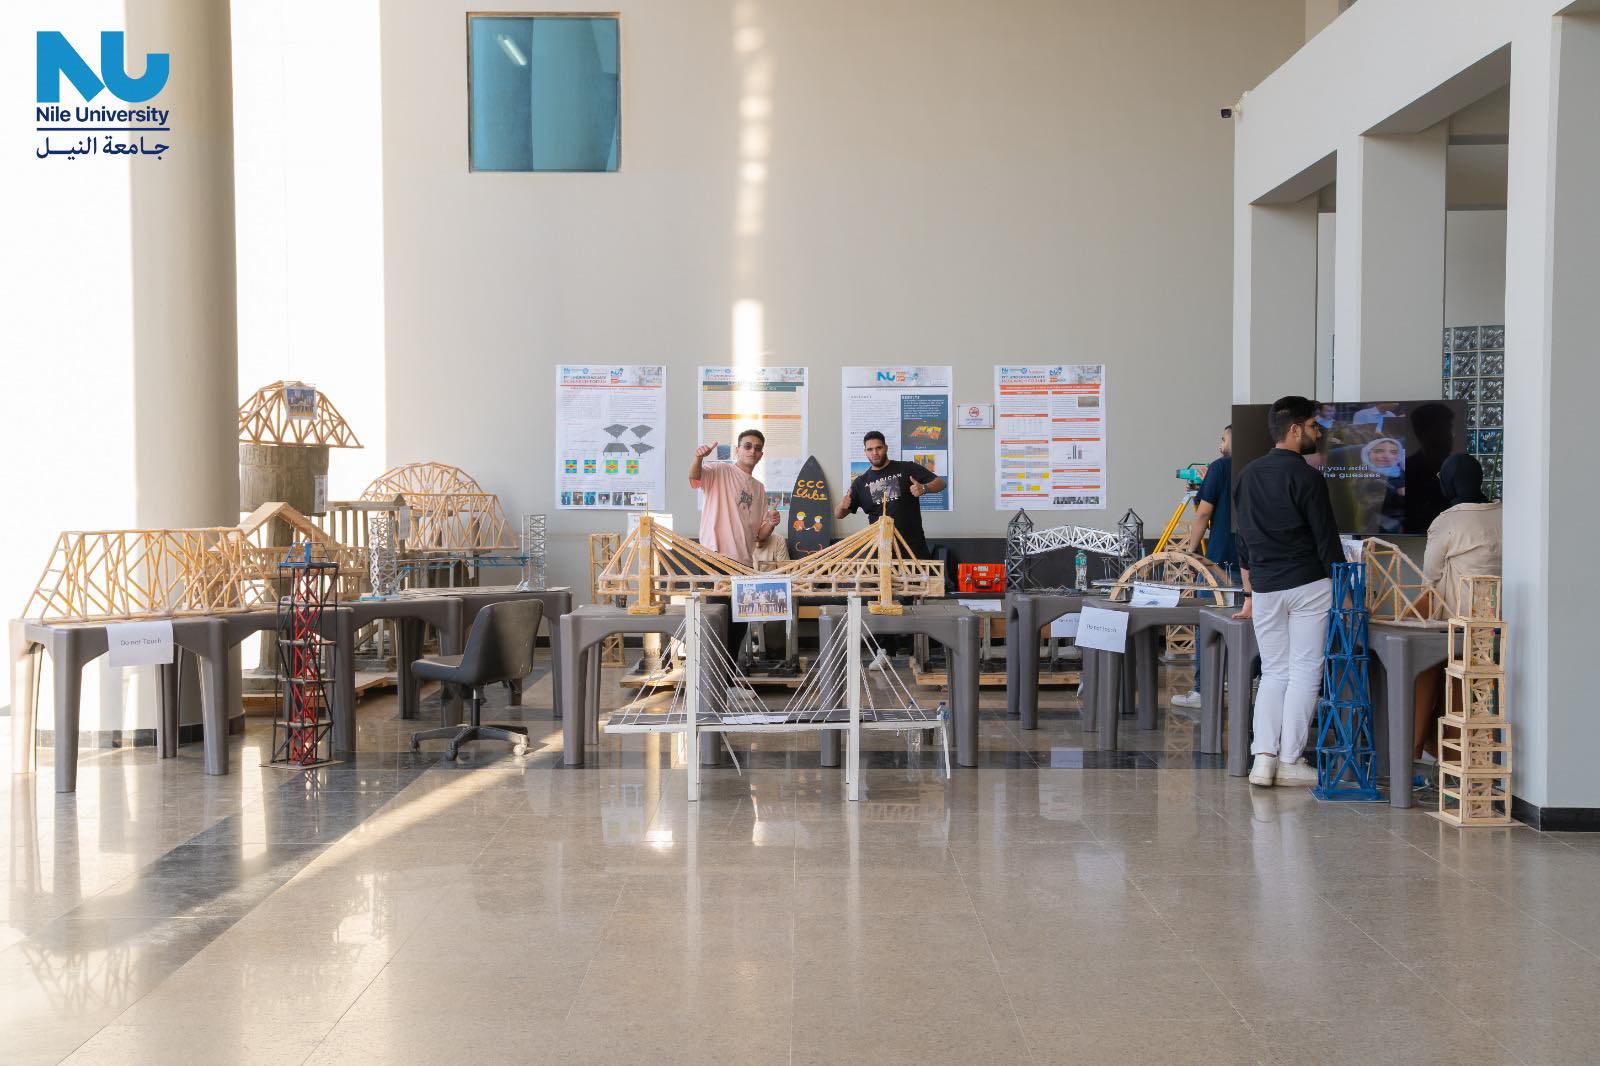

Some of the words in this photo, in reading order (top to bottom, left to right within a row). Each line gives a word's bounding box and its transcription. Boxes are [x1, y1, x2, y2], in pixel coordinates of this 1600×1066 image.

[877, 371, 895, 381] NU
[797, 479, 825, 489] CCC
[143, 636, 162, 645] Touch
